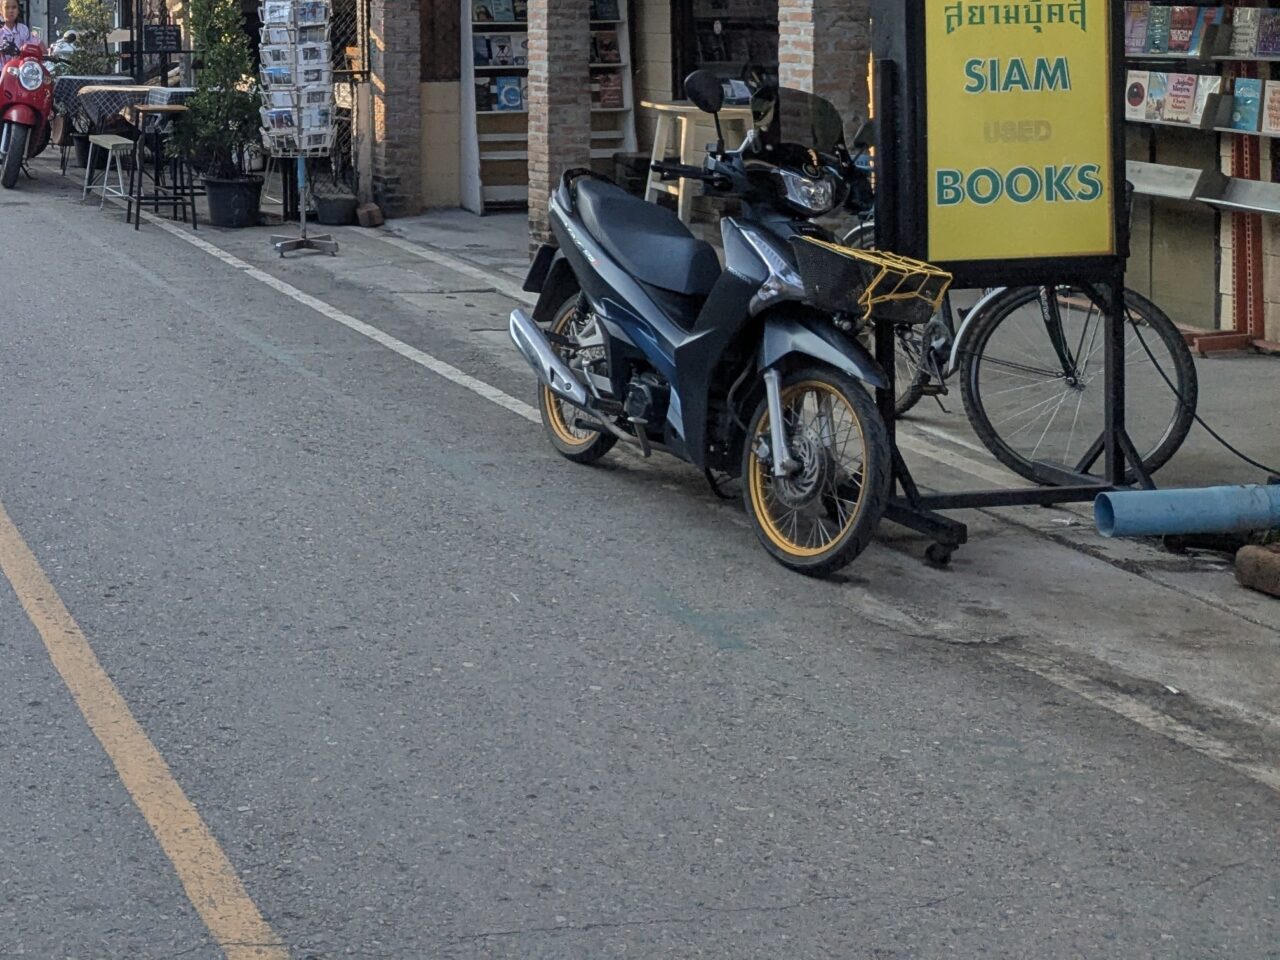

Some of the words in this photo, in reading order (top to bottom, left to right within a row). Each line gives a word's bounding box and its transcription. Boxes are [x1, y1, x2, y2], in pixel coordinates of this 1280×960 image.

[964, 55, 1071, 95] SIAM
[983, 119, 1053, 145] USED
[935, 163, 1104, 207] BOOKS
